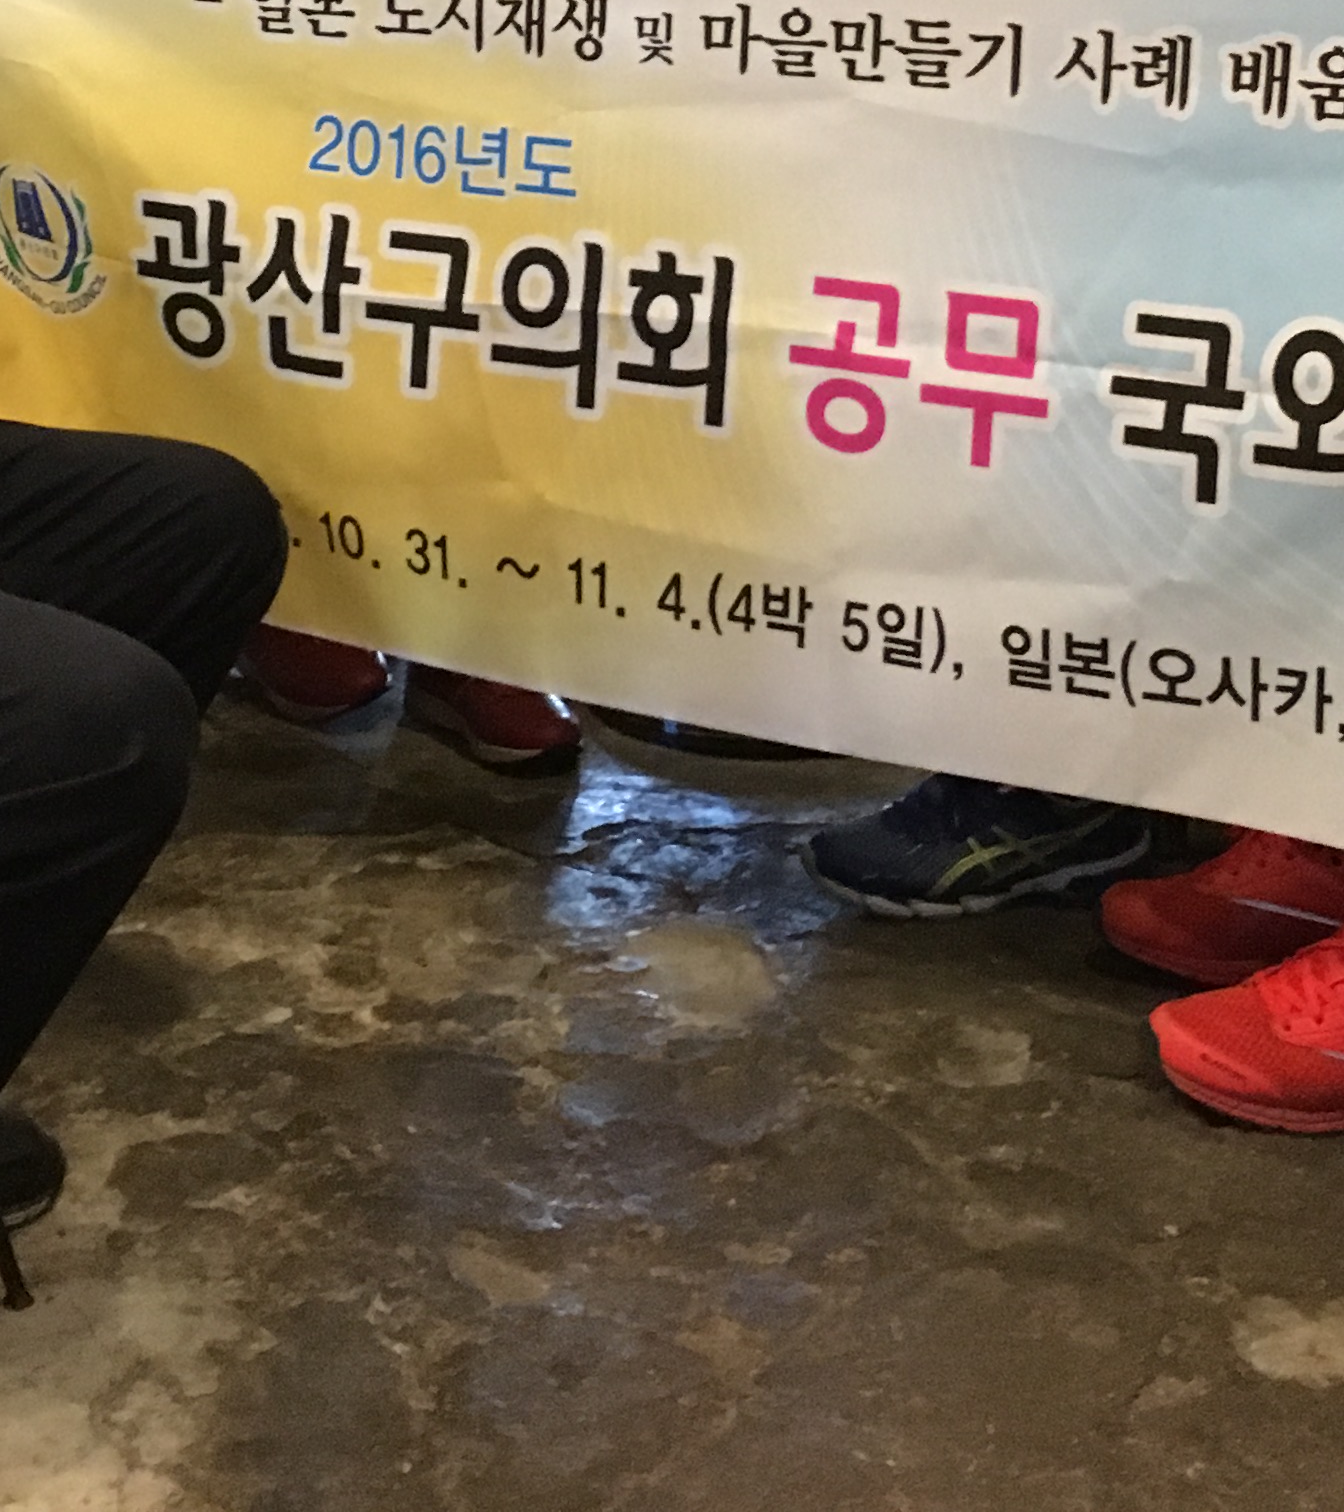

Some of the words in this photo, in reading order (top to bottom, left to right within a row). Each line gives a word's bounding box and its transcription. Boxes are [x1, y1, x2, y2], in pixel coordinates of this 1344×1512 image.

[635, 12, 673, 65] 및
[699, 4, 1022, 97] 마을만들기
[1056, 30, 1192, 110] 사례
[310, 116, 575, 196] 2016년도
[137, 197, 734, 427] 광산구의회
[790, 276, 1048, 467] 공무
[319, 512, 380, 569] 10.
[406, 529, 467, 588] 31.
[568, 558, 625, 617] 11.
[842, 601, 962, 680] 5일),
